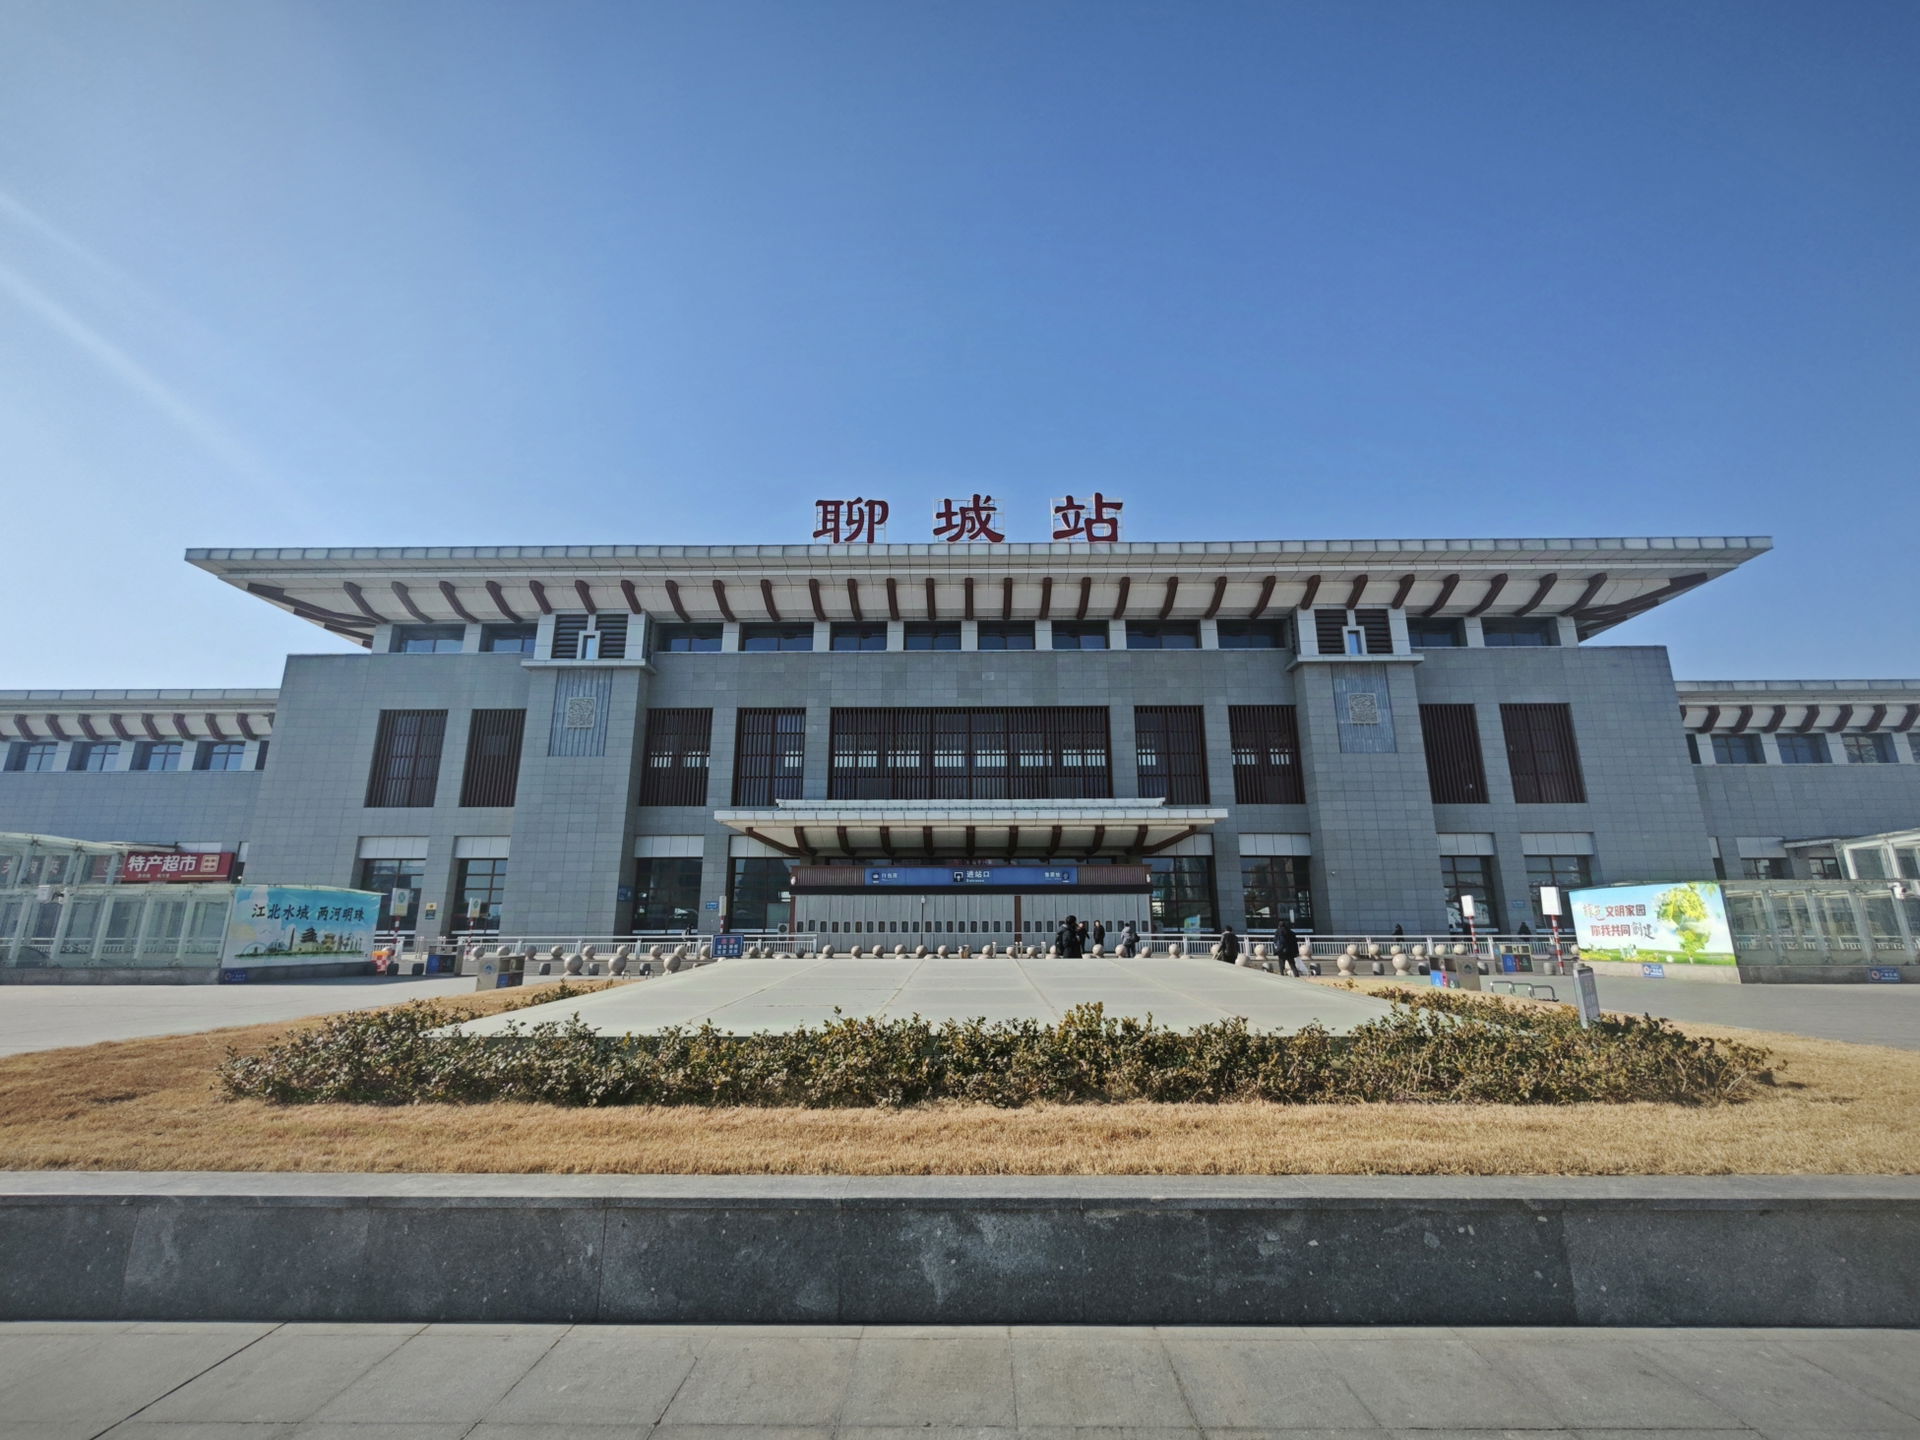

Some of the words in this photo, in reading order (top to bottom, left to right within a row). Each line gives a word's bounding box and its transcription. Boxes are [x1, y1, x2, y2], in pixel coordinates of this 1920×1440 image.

[813, 492, 1124, 543] 聊城站
[127, 855, 197, 872] 特产超市
[966, 870, 990, 878] 进站口
[252, 904, 310, 920] 江北水城
[317, 906, 365, 922] 两河明珠
